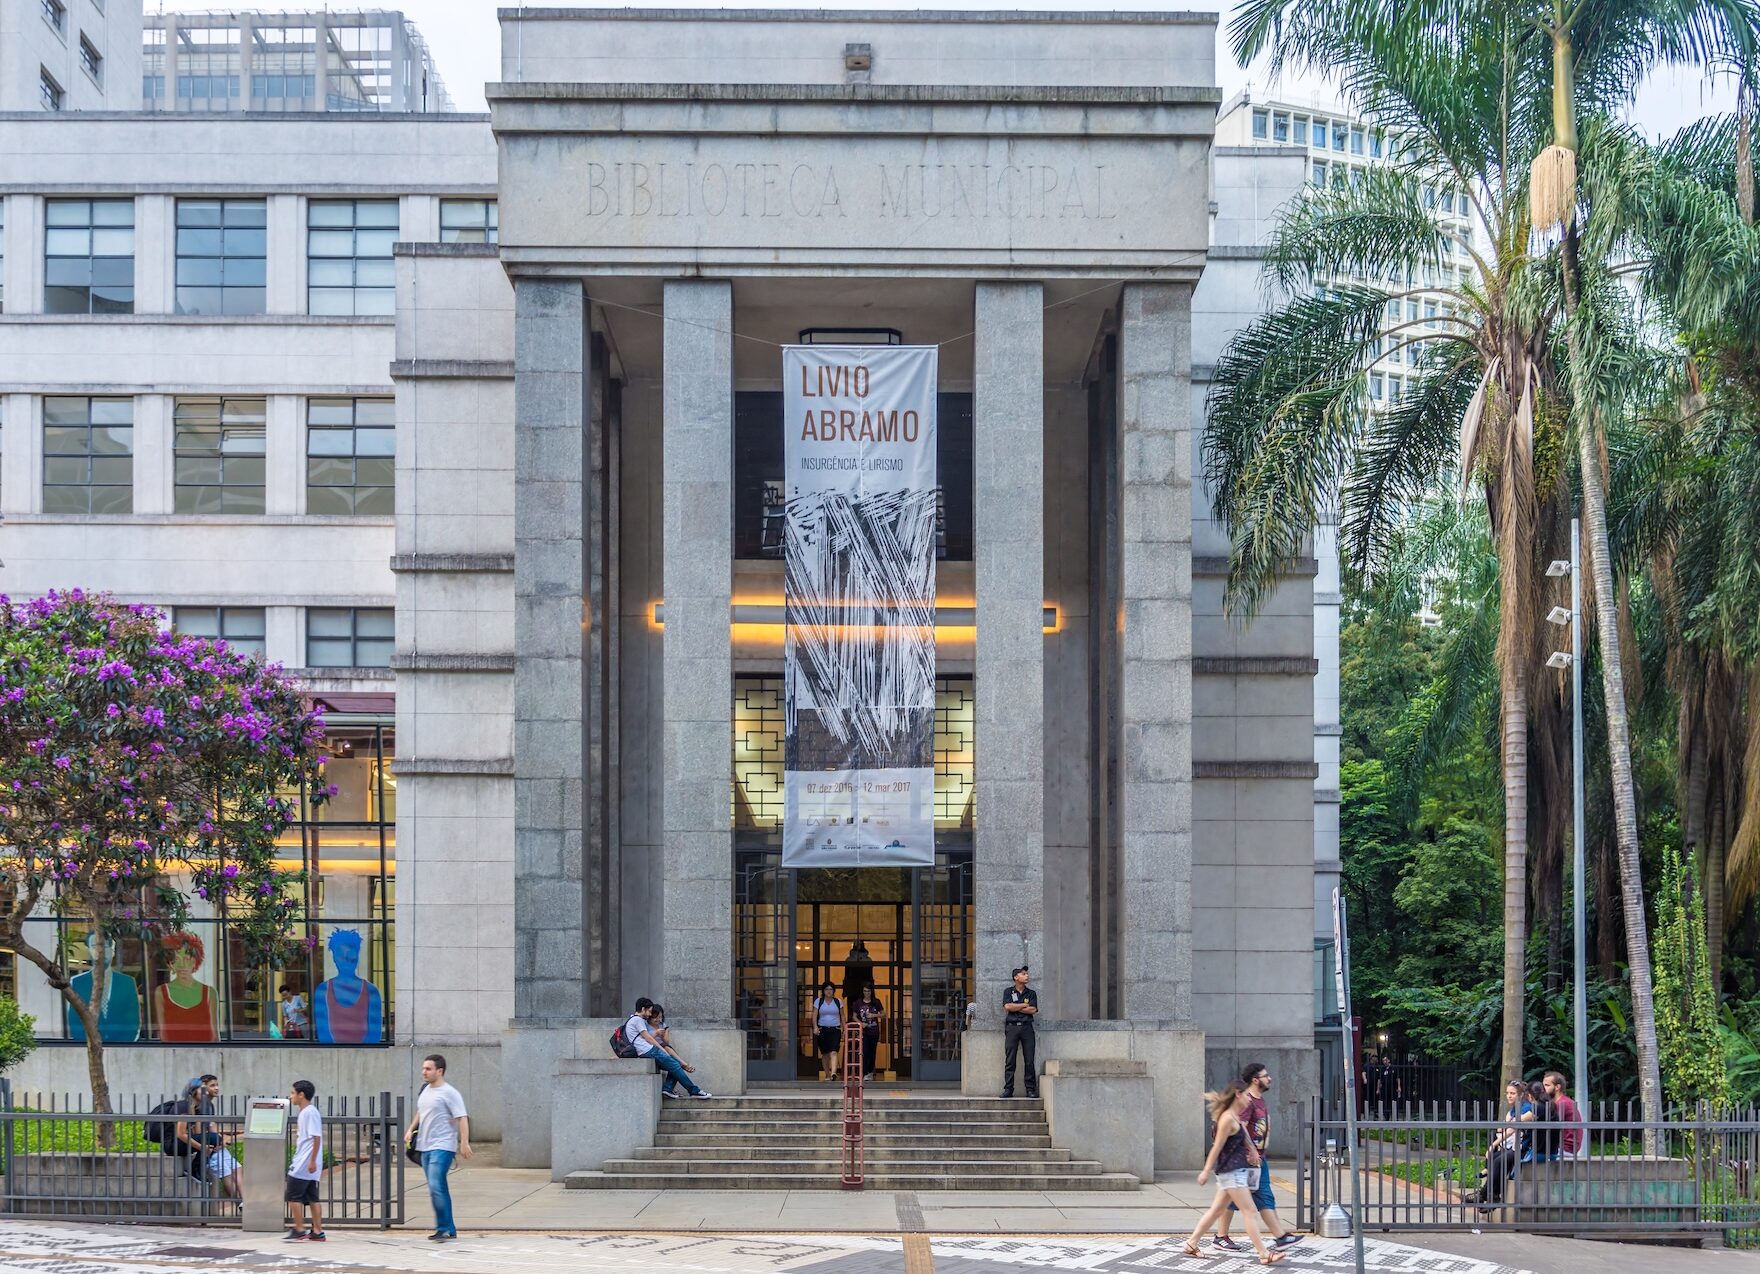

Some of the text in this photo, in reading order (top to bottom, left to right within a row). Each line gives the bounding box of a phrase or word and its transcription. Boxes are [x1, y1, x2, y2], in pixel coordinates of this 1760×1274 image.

[586, 162, 1117, 218] BIBLIOTECA MUNICIPAL
[802, 365, 869, 398] LIVIO
[801, 410, 919, 442] ABRAMO
[801, 456, 903, 471] INSURGÊNCIA E LIRISMO
[819, 783, 832, 793] dez
[834, 782, 853, 793] 2016
[863, 782, 872, 792] 12
[875, 784, 890, 793] mar
[892, 782, 911, 792] 2017
